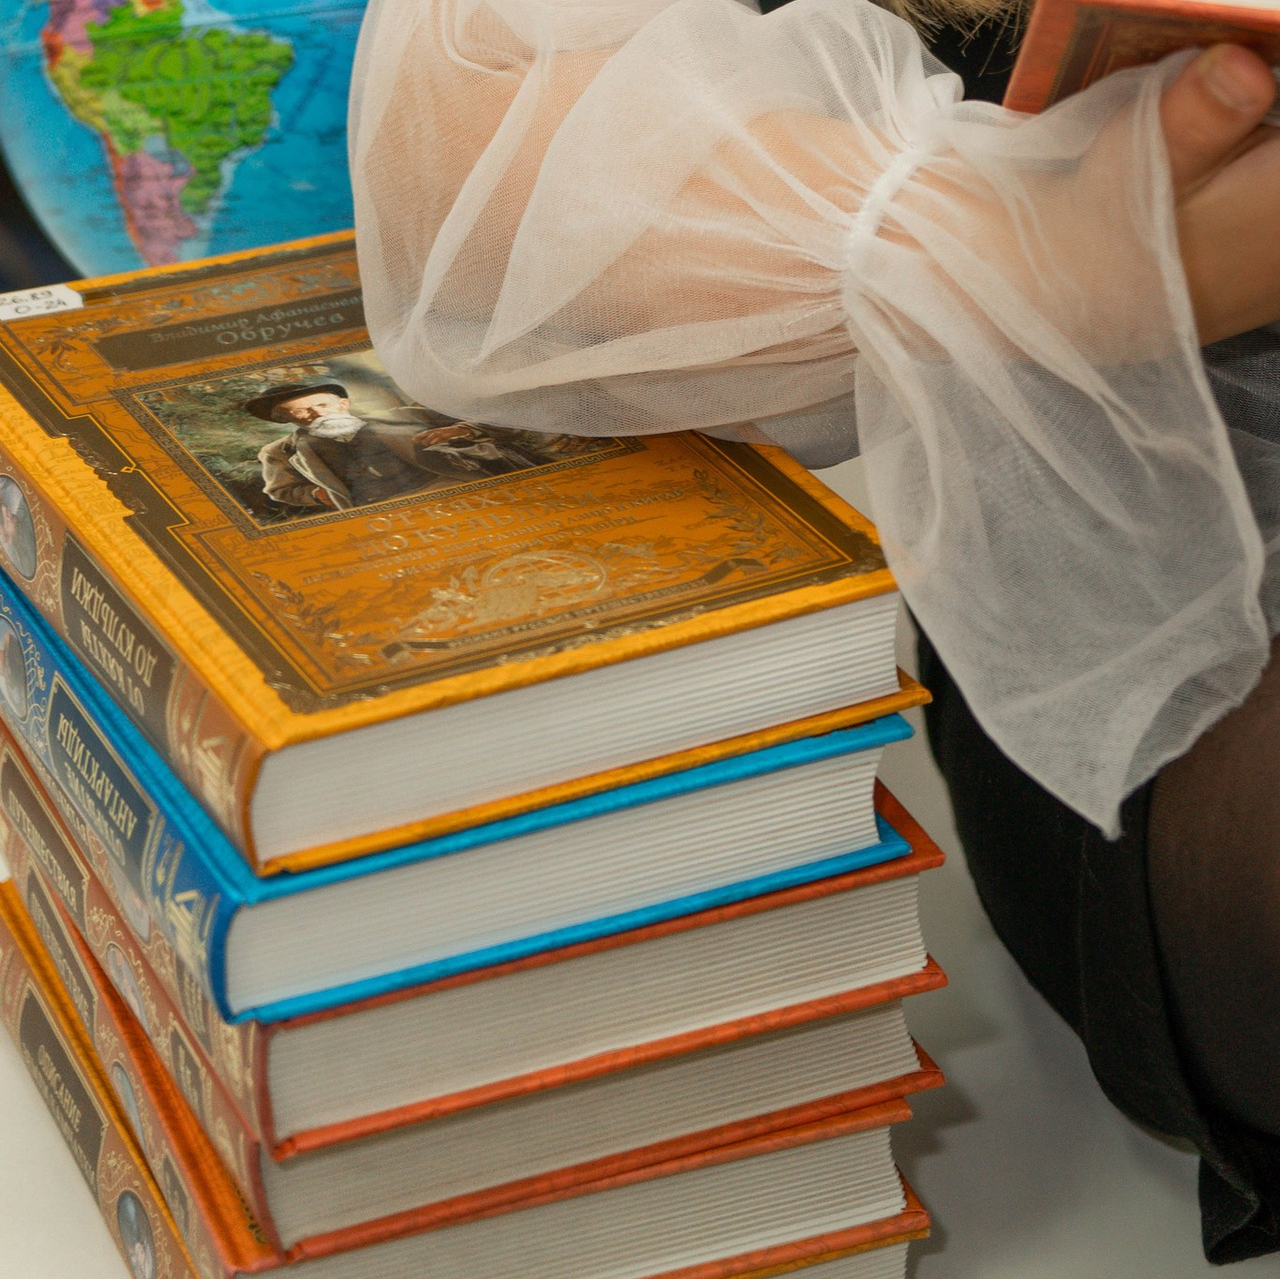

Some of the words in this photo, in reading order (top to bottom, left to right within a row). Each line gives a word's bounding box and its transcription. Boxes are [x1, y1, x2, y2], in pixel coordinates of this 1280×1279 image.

[151, 317, 249, 342] Владимир
[216, 312, 345, 345] Обручев
[355, 534, 409, 560] ДО
[413, 490, 602, 544] КУЛЬДЖИ
[366, 510, 416, 534] ОТ
[419, 481, 554, 521] КЯХТЫ
[71, 567, 137, 654] КУЛЬДЖИ
[80, 619, 126, 697] КЯХТЫ
[134, 644, 159, 688] ДО
[56, 712, 138, 840] АНТАРКТИДЫ
